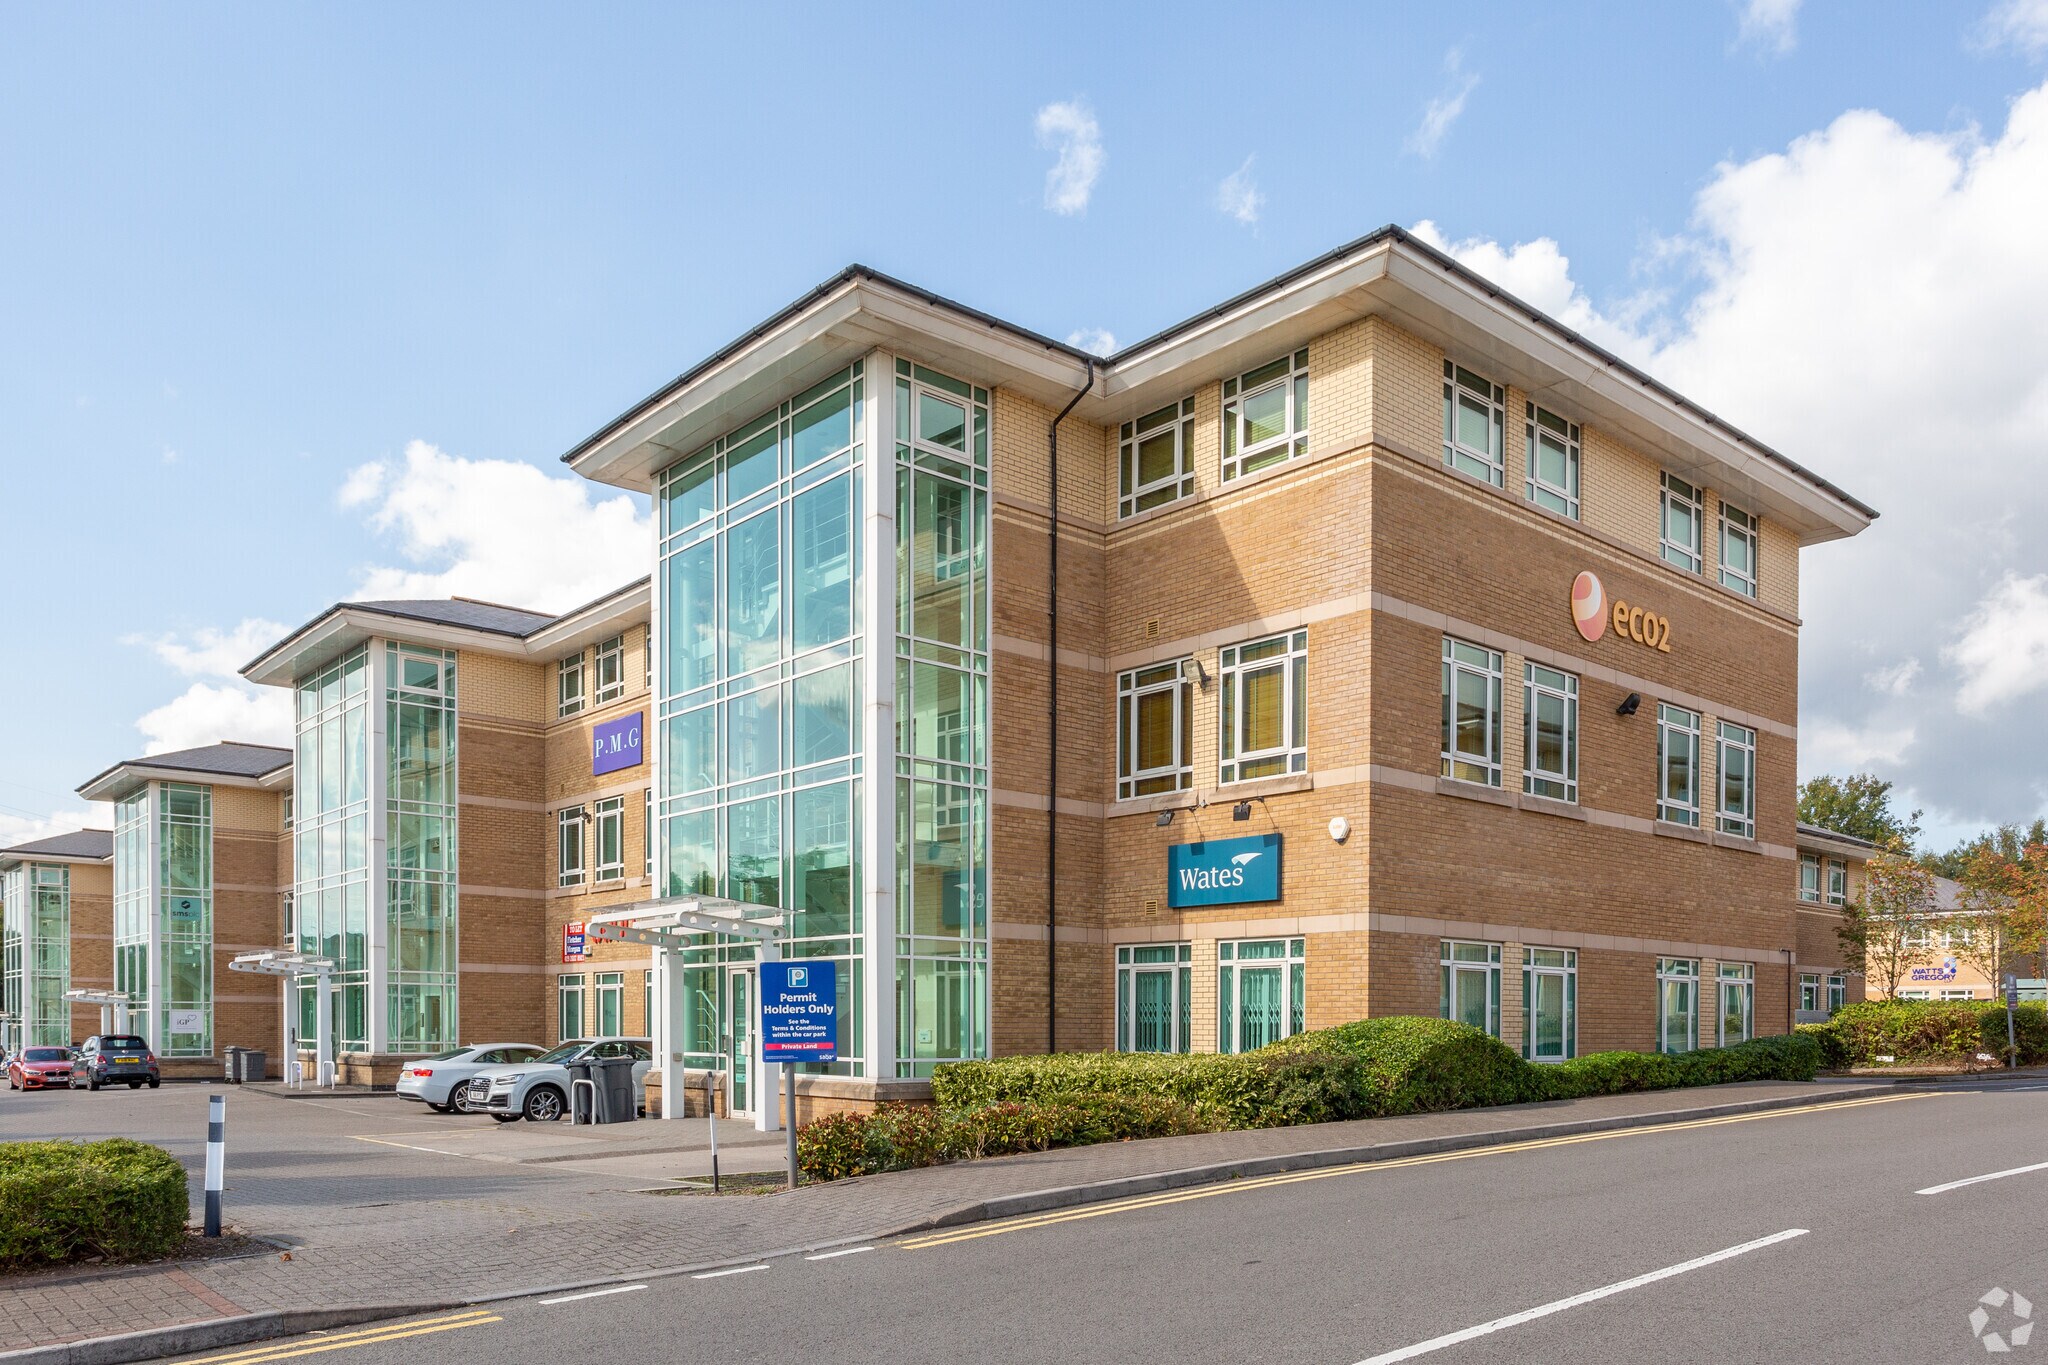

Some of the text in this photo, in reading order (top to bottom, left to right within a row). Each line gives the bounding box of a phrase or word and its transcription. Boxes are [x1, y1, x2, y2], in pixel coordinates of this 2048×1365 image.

[1613, 600, 1670, 653] eco2
[1179, 866, 1244, 891] Wates
[780, 993, 817, 1002] Permit
[764, 1004, 834, 1015] Holders Only
